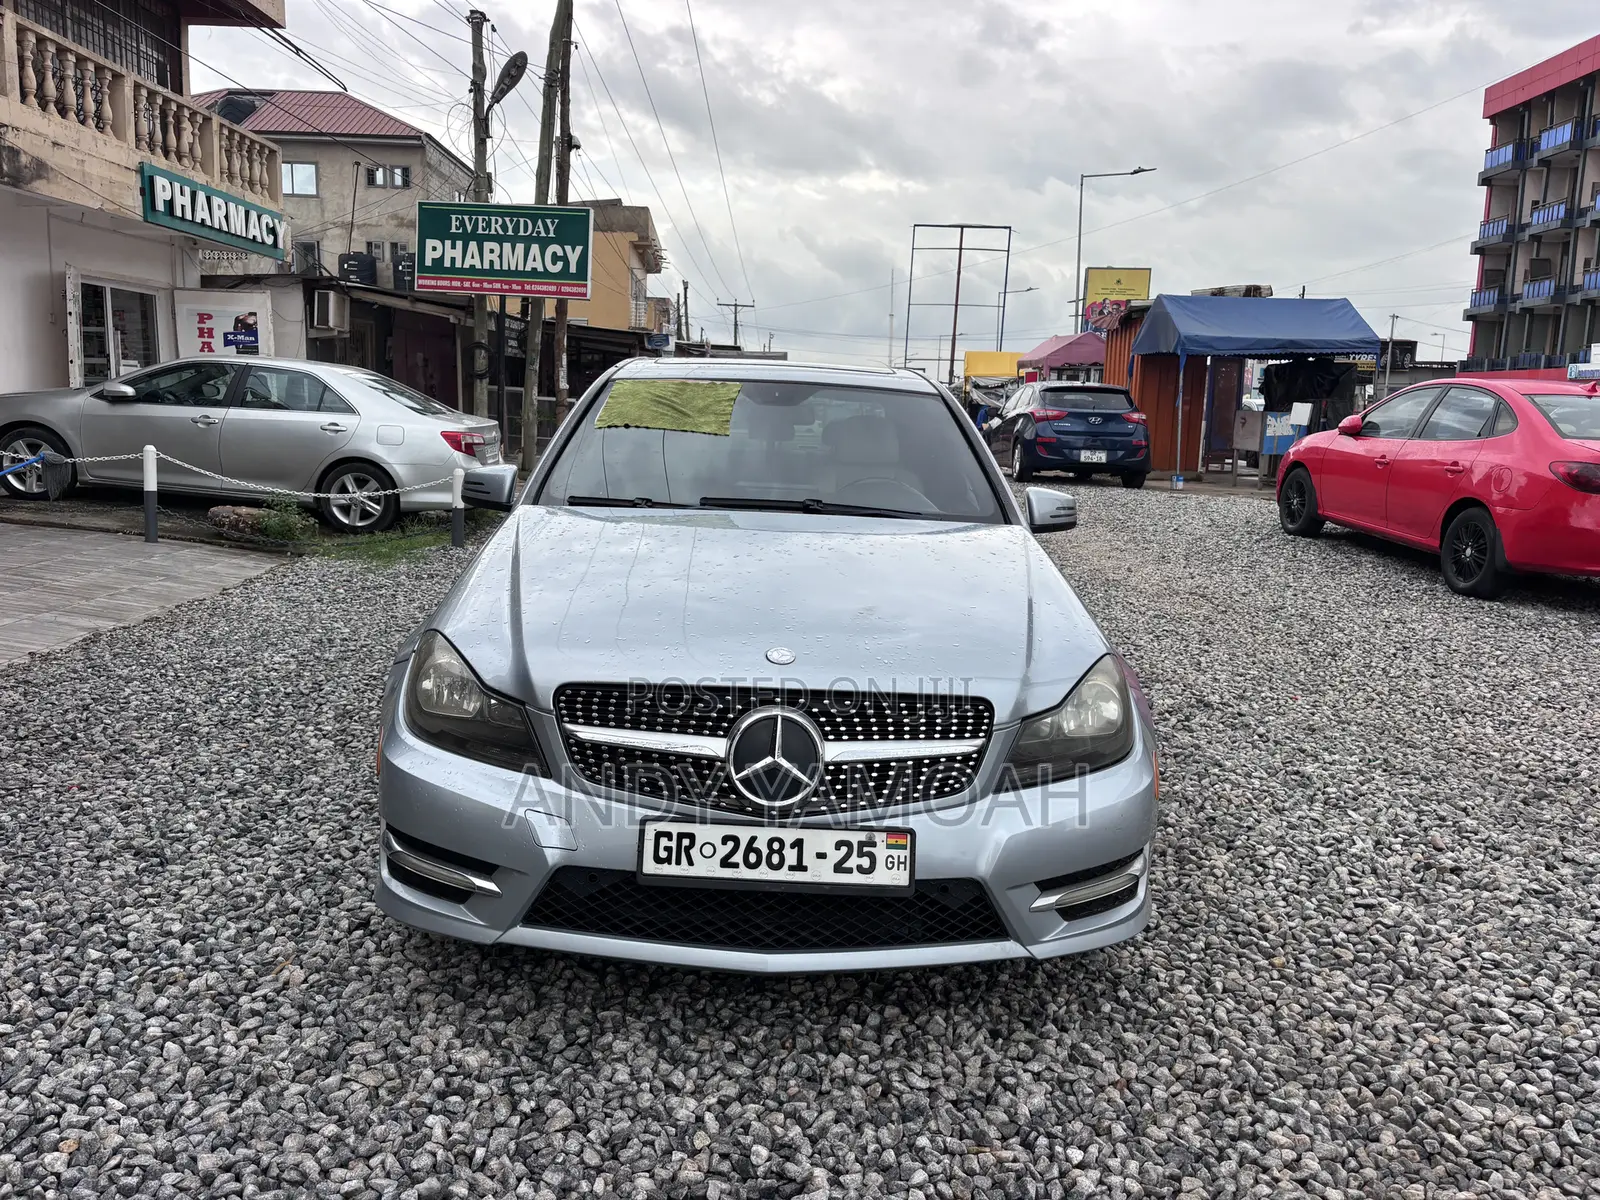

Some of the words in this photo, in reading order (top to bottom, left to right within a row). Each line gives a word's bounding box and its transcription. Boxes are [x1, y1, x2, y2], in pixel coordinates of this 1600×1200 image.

[153, 175, 287, 249] PHARMACY
[450, 214, 559, 238] EVERYDAY
[424, 238, 584, 274] PHARMACY
[227, 334, 256, 342] X-Man
[653, 830, 696, 867] GR
[885, 854, 908, 871] GH
